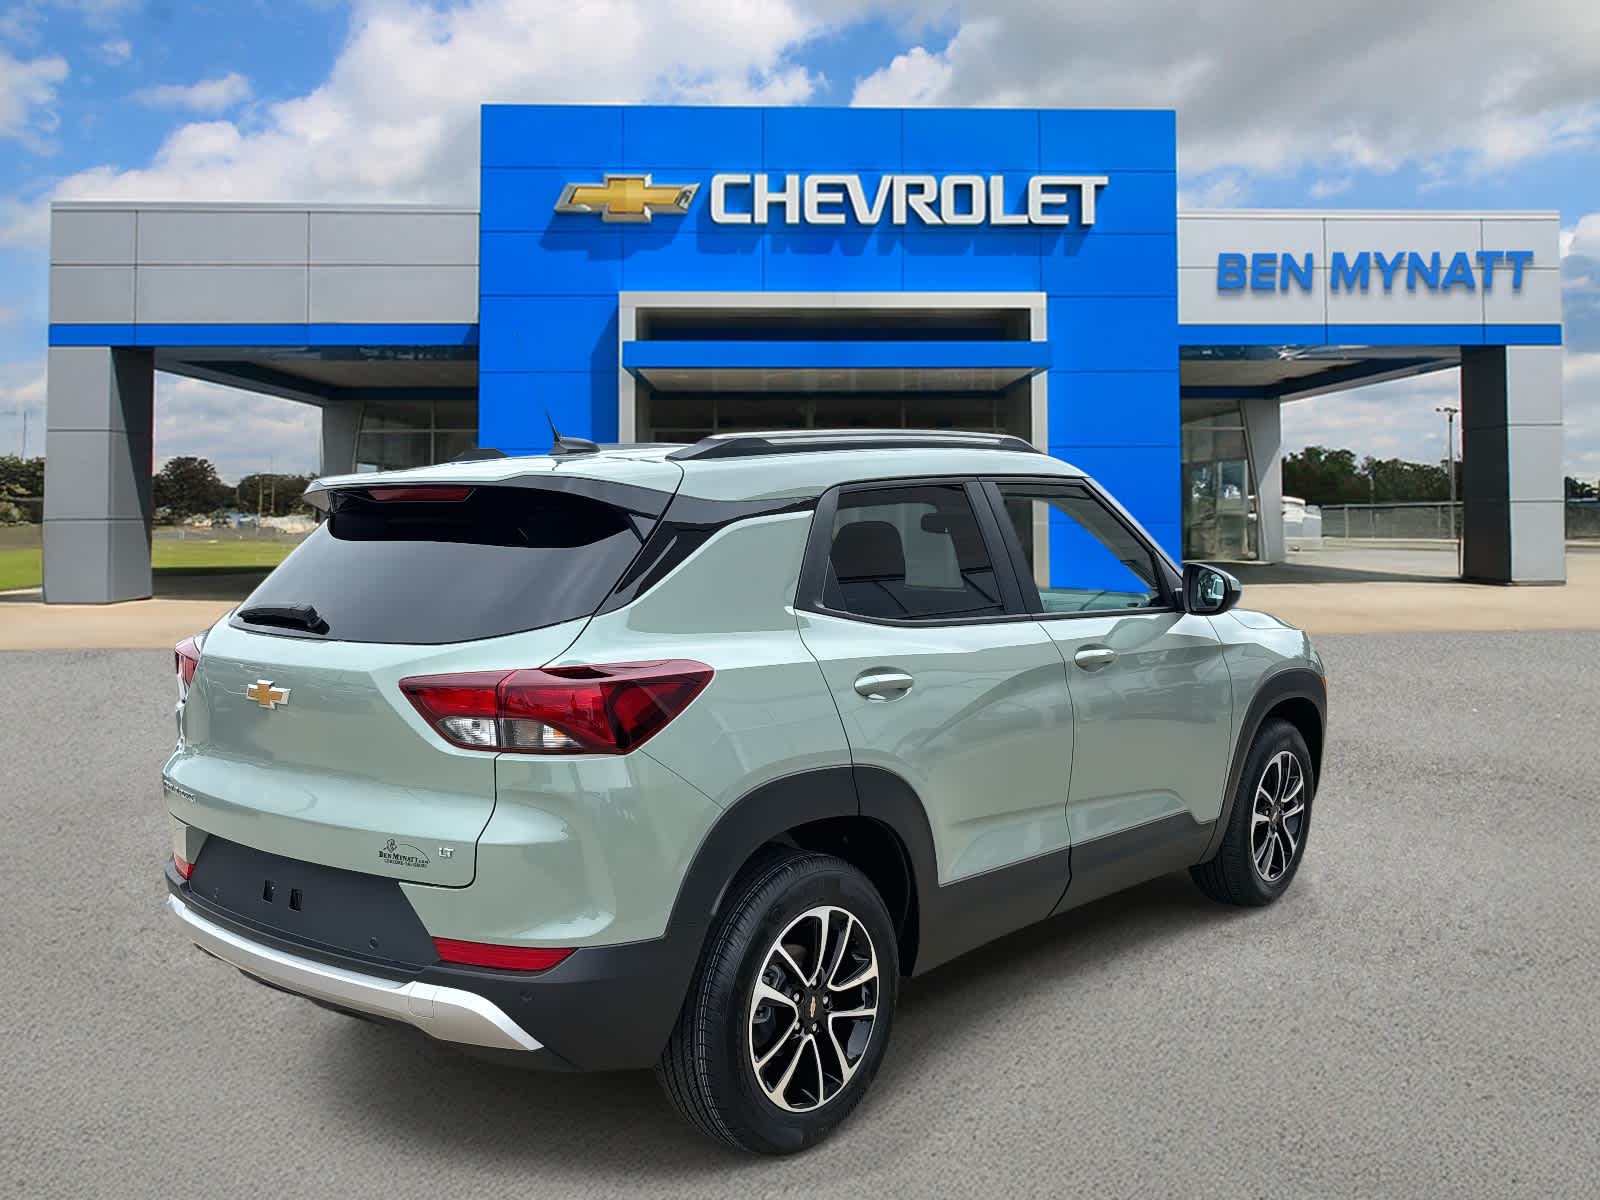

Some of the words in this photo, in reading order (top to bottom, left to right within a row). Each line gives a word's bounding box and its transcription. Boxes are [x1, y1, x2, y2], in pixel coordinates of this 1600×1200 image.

[710, 173, 1109, 225] CHEVROLET
[1217, 252, 1313, 290] BEN
[1330, 251, 1533, 290] MYNATT
[438, 847, 454, 858] LT
